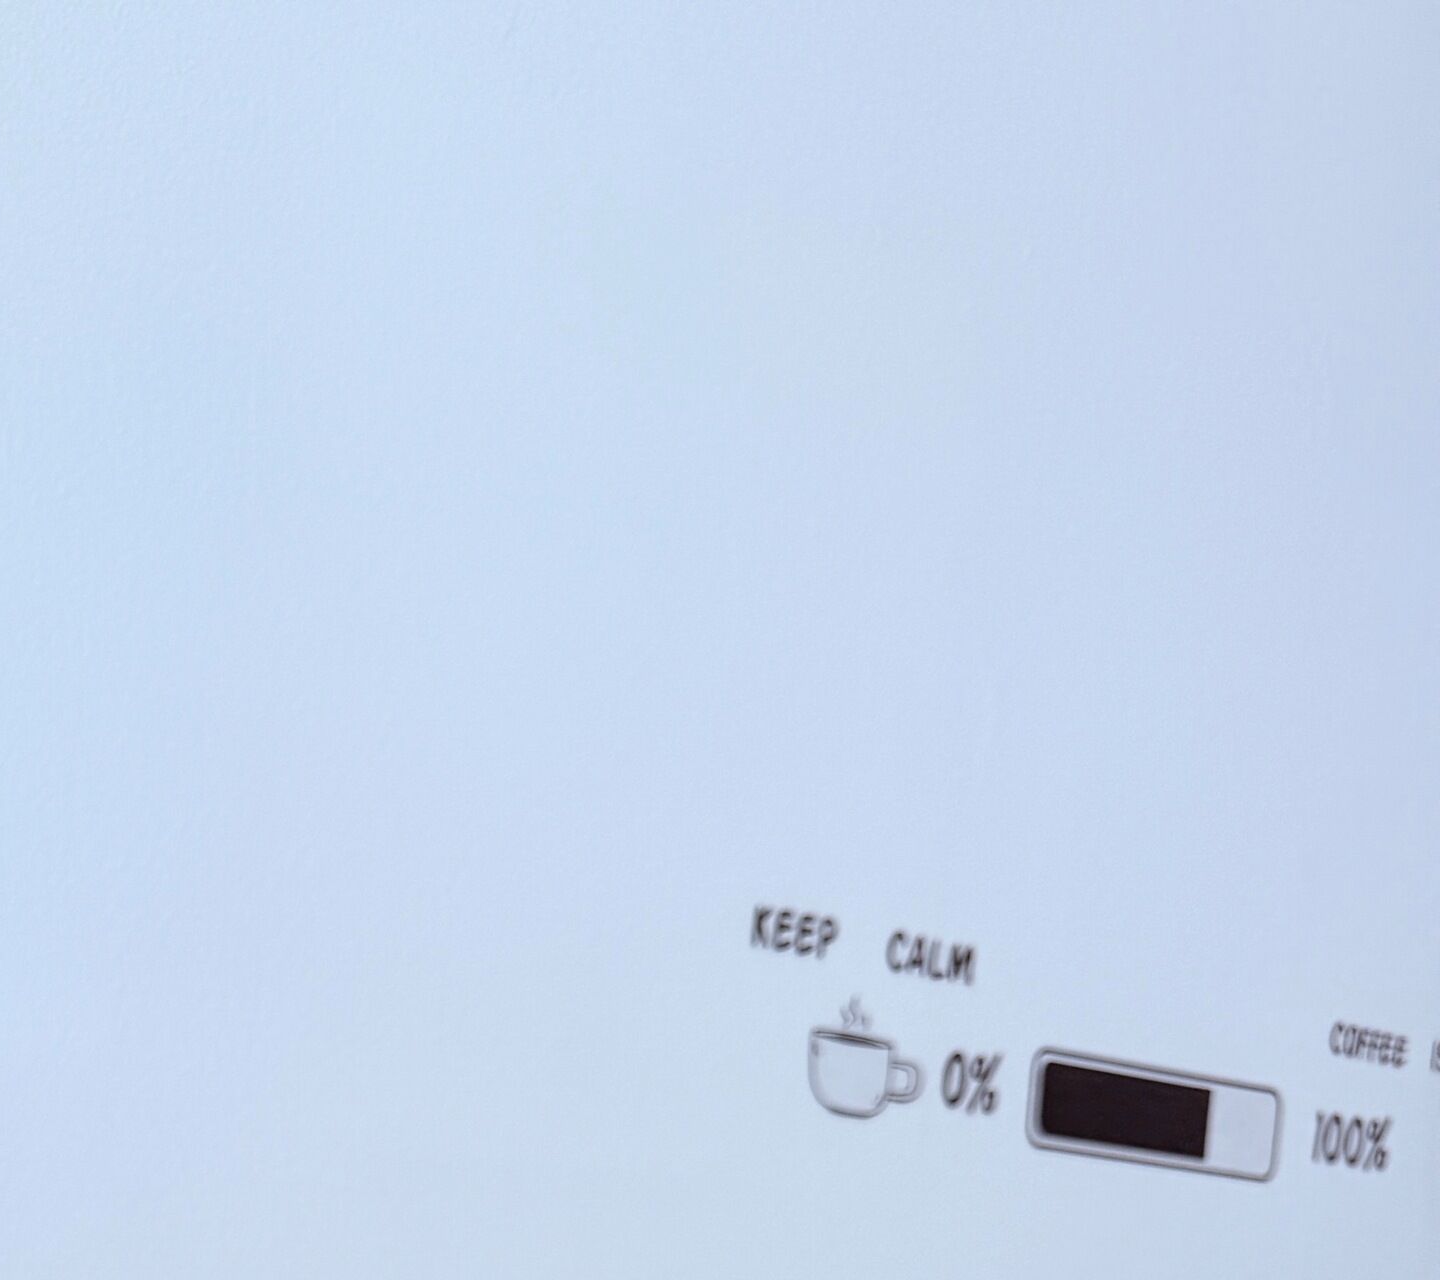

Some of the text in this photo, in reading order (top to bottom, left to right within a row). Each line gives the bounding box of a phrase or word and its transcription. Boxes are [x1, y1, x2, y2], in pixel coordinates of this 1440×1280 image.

[750, 903, 978, 986] KEEP CALM
[1329, 1021, 1410, 1070] COFFEE
[940, 1050, 1006, 1115] 0%
[1312, 1110, 1393, 1172] 100%
